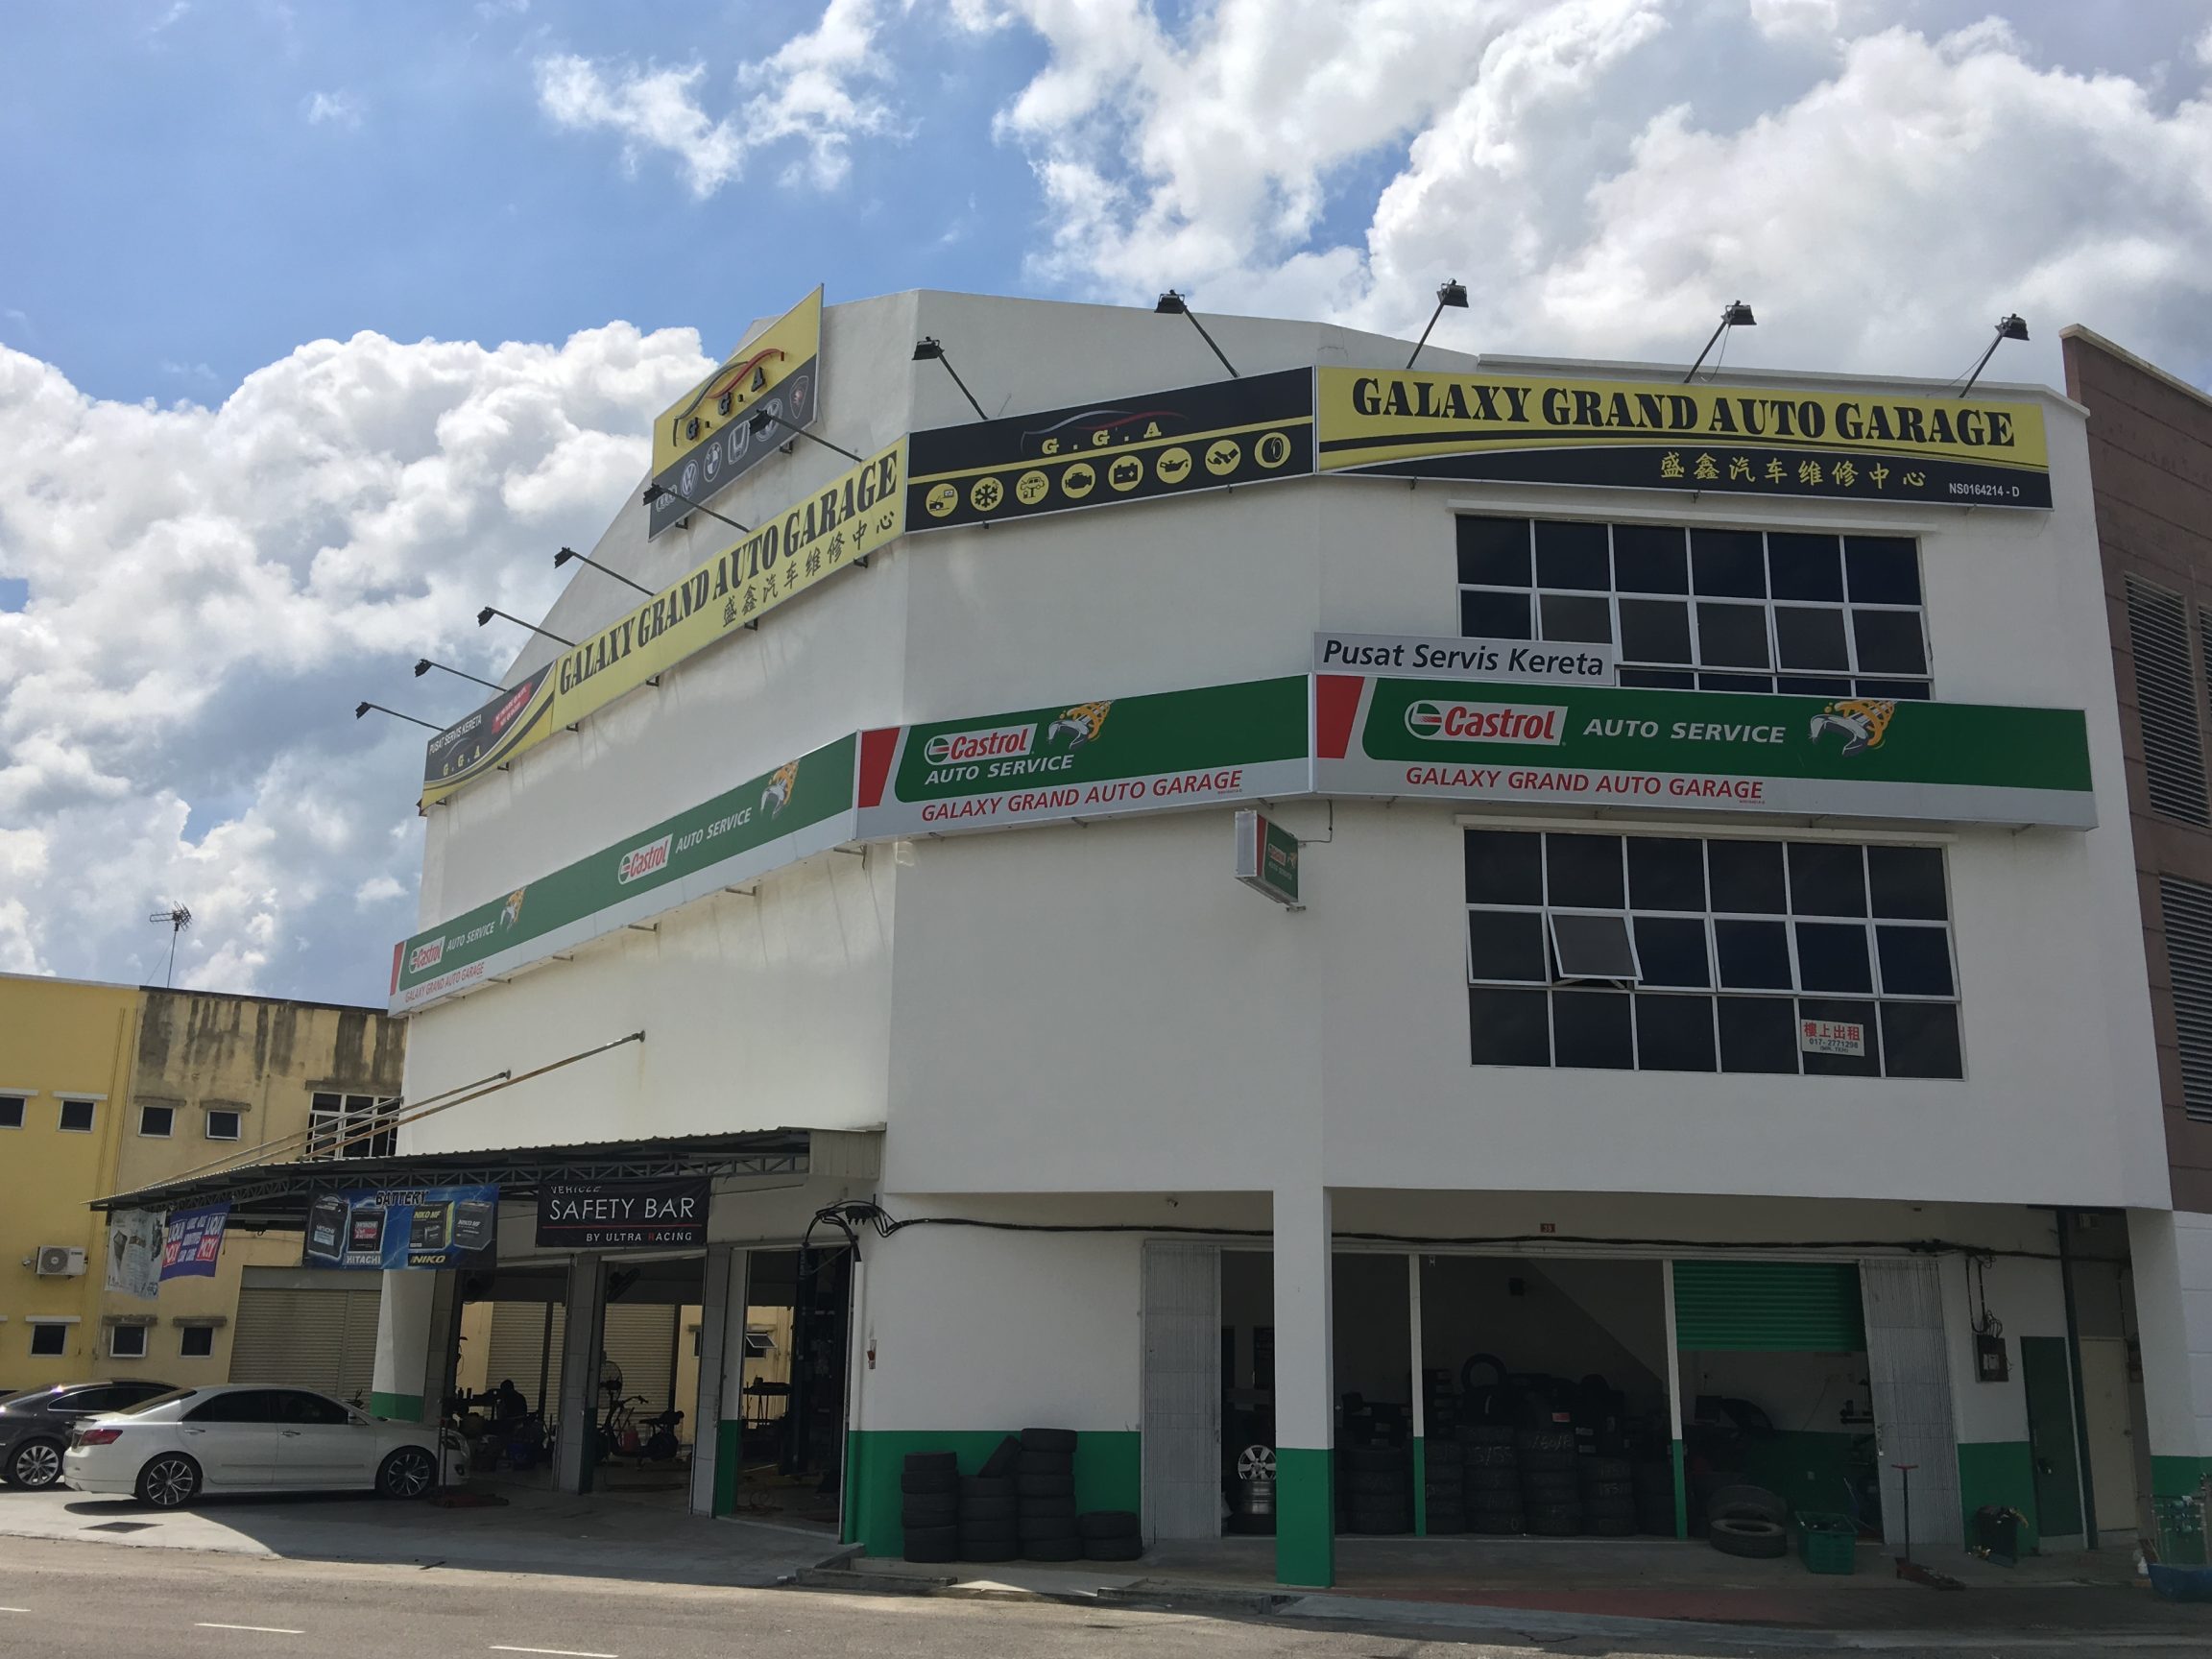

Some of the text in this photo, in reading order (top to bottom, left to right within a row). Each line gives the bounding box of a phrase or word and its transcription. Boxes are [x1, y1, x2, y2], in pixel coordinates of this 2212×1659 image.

[1352, 377, 2015, 447] GALAXY GRAND AUTO GARAGE
[1660, 451, 1926, 489] 盛鑫汽车维修中心
[560, 449, 898, 695] GALAXY GRAND AUTO GARAGE
[723, 511, 894, 628] 盛鑫汽车维修中心
[1323, 639, 1604, 676] Pusat Servis Kereta
[1444, 707, 1786, 743] Castrol AUTO SERVICE
[950, 729, 1028, 759] Castrol
[925, 755, 1074, 785] AUTO SERVICE
[1406, 766, 1763, 799] GALAXY GRAND AUTO GARAGE
[922, 770, 1242, 822] GALAXY GRAND AUTO GARAGE
[629, 806, 752, 878] Castrol AUTO SERVICE
[416, 921, 495, 970] Castrol AUTO SERVICE
[461, 961, 485, 980] GARAGE
[375, 1190, 429, 1207] BATTERY
[414, 1210, 442, 1219] NIKO MF
[549, 1197, 695, 1220] SAFETY BAR
[586, 1232, 692, 1242] BY ULTRA RACING
[347, 1255, 381, 1264] HITACHI
